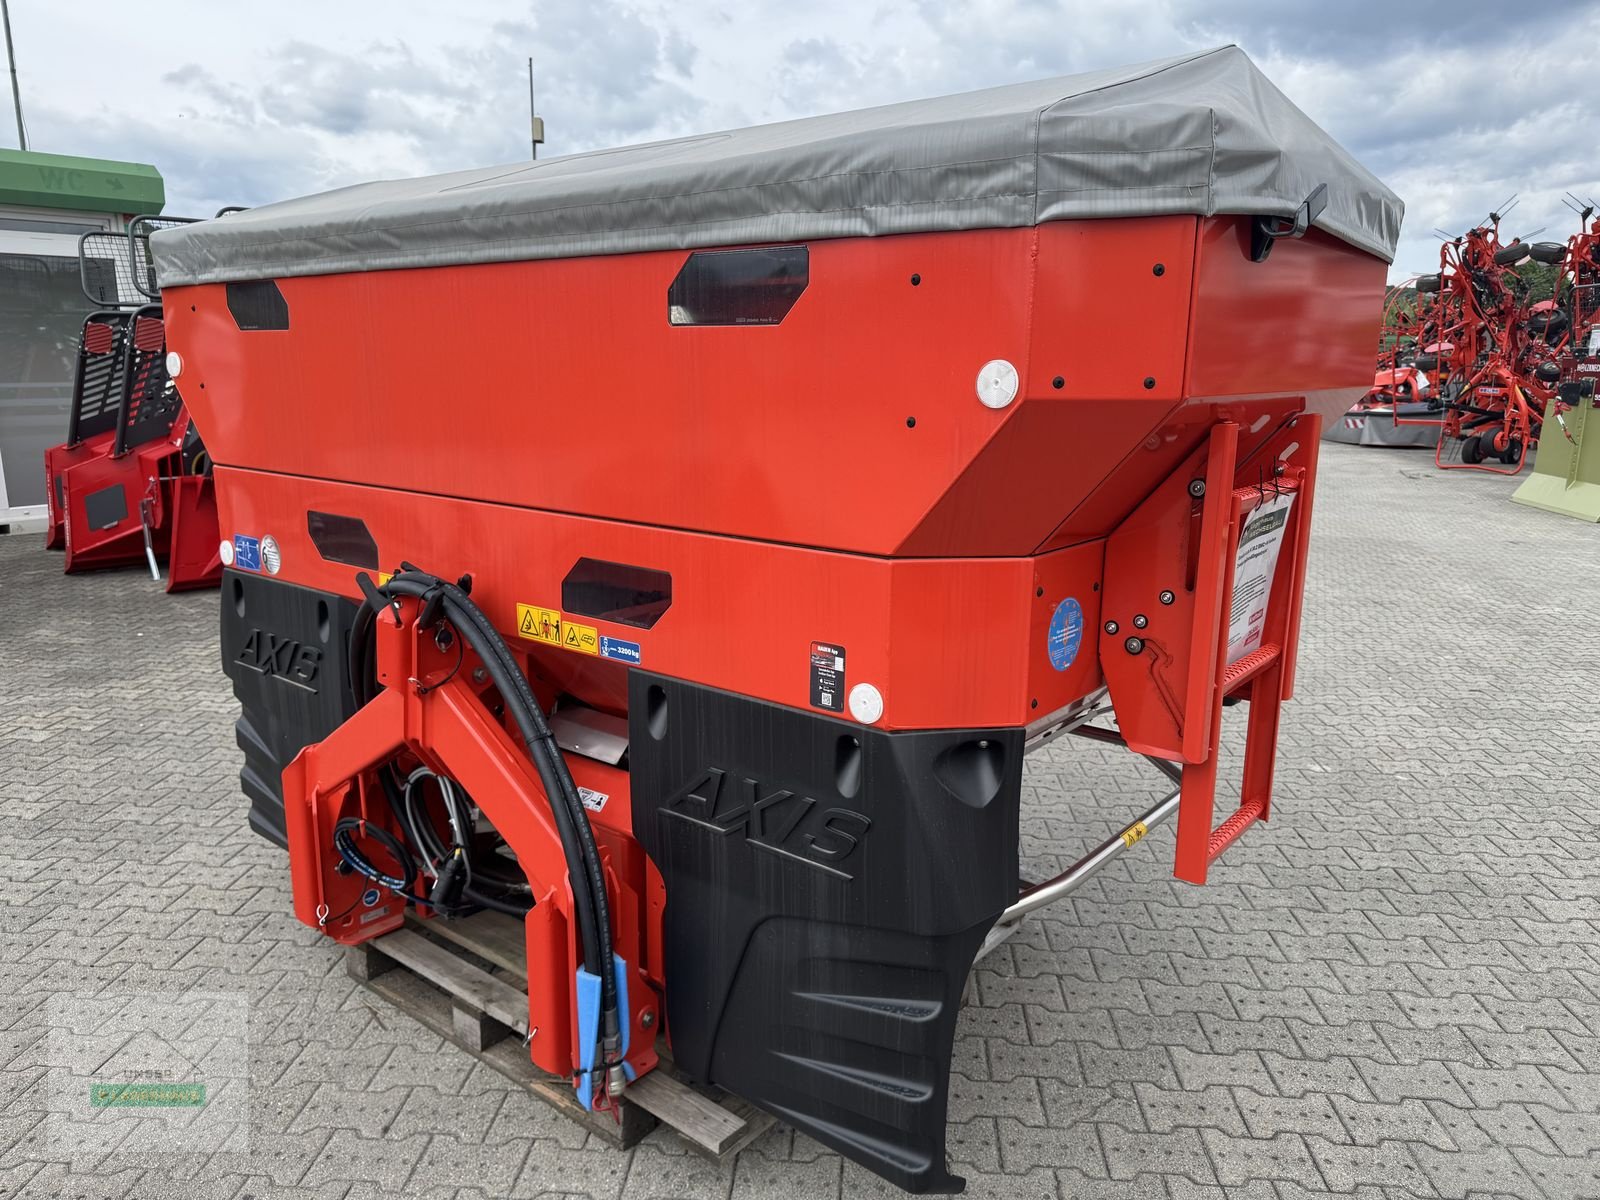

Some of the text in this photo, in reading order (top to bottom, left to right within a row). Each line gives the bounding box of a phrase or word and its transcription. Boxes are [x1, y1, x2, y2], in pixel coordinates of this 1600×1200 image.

[39, 168, 84, 191] WC
[239, 629, 324, 683] AXIS
[617, 646, 640, 659] 3200 kg
[667, 767, 872, 862] AXIS
